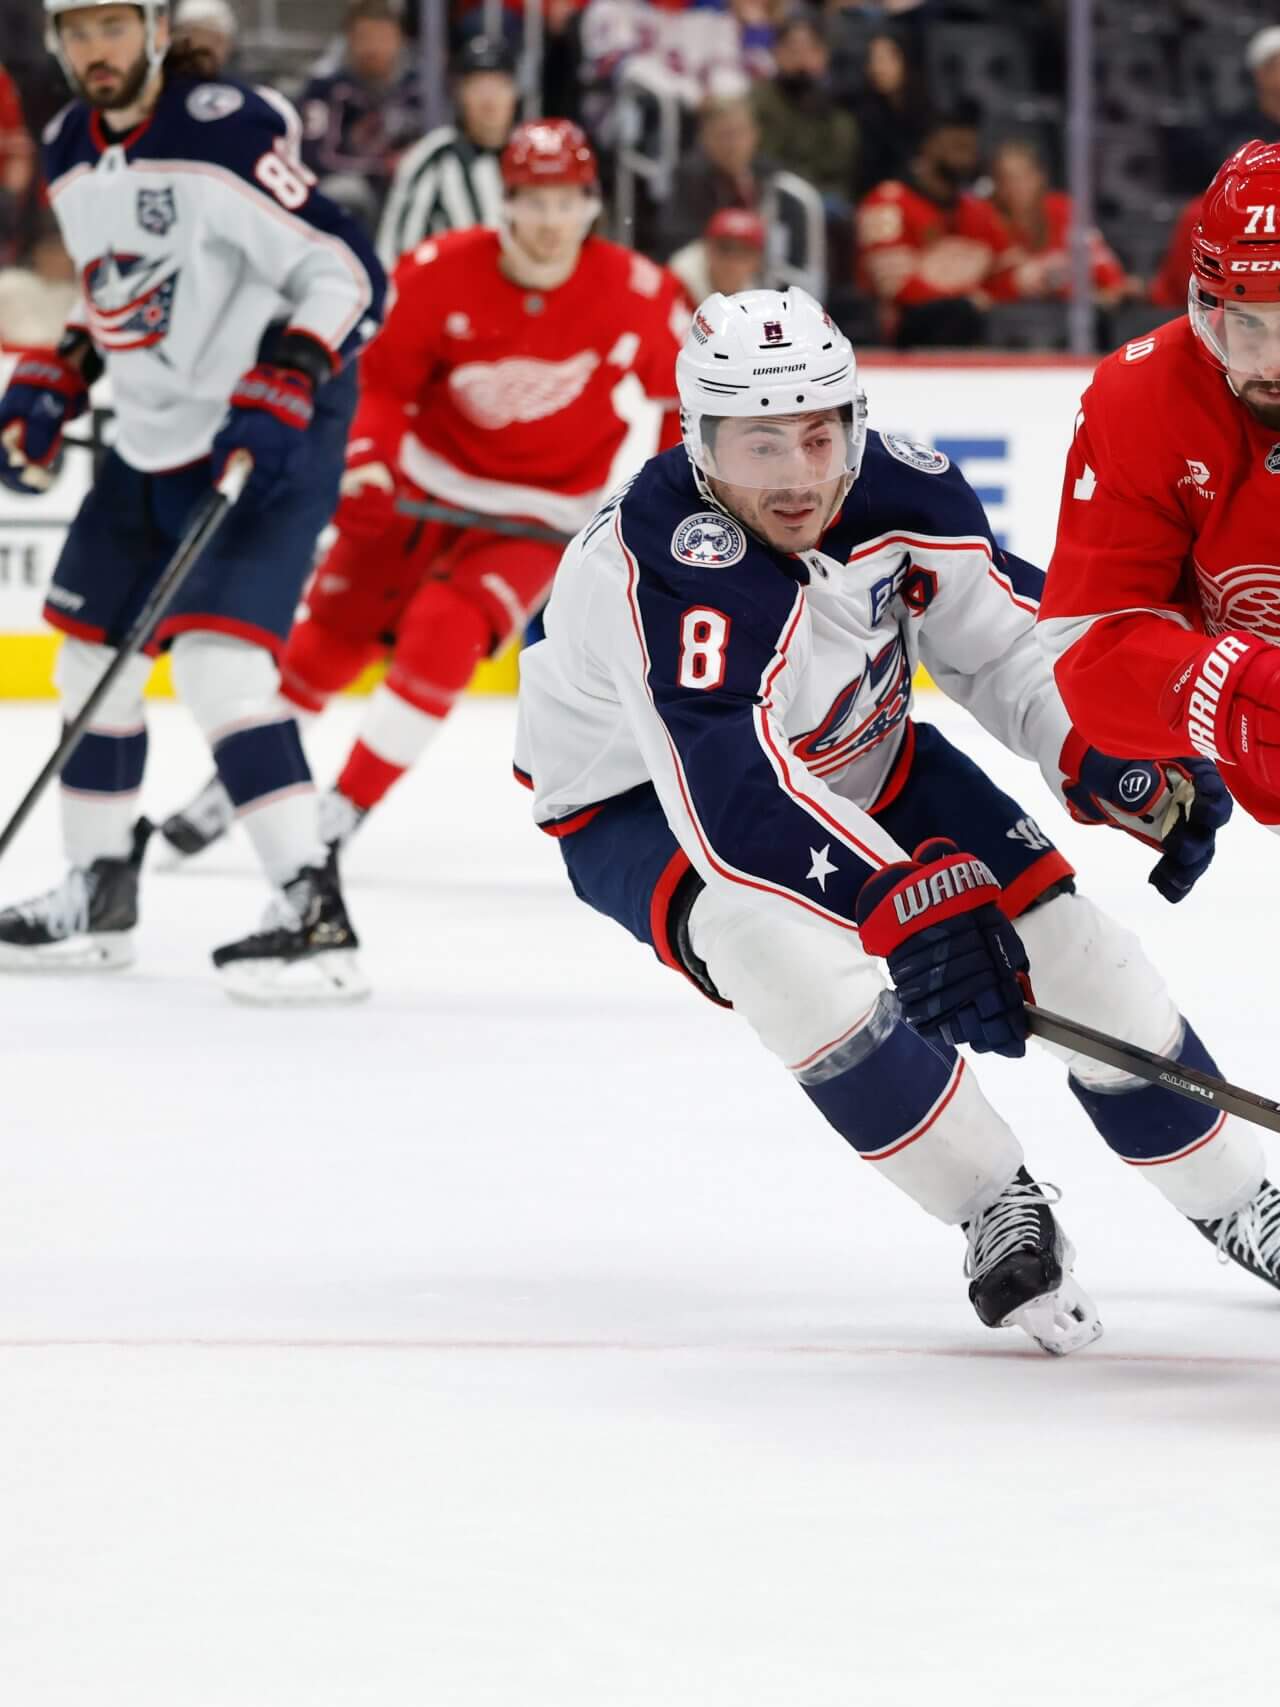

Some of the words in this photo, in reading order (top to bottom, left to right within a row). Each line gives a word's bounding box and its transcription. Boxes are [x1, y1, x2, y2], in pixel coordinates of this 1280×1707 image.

[1244, 204, 1276, 234] 71
[752, 363, 807, 376] WARRIOR
[677, 606, 731, 691] 8
[1188, 635, 1250, 766] ARRIOR
